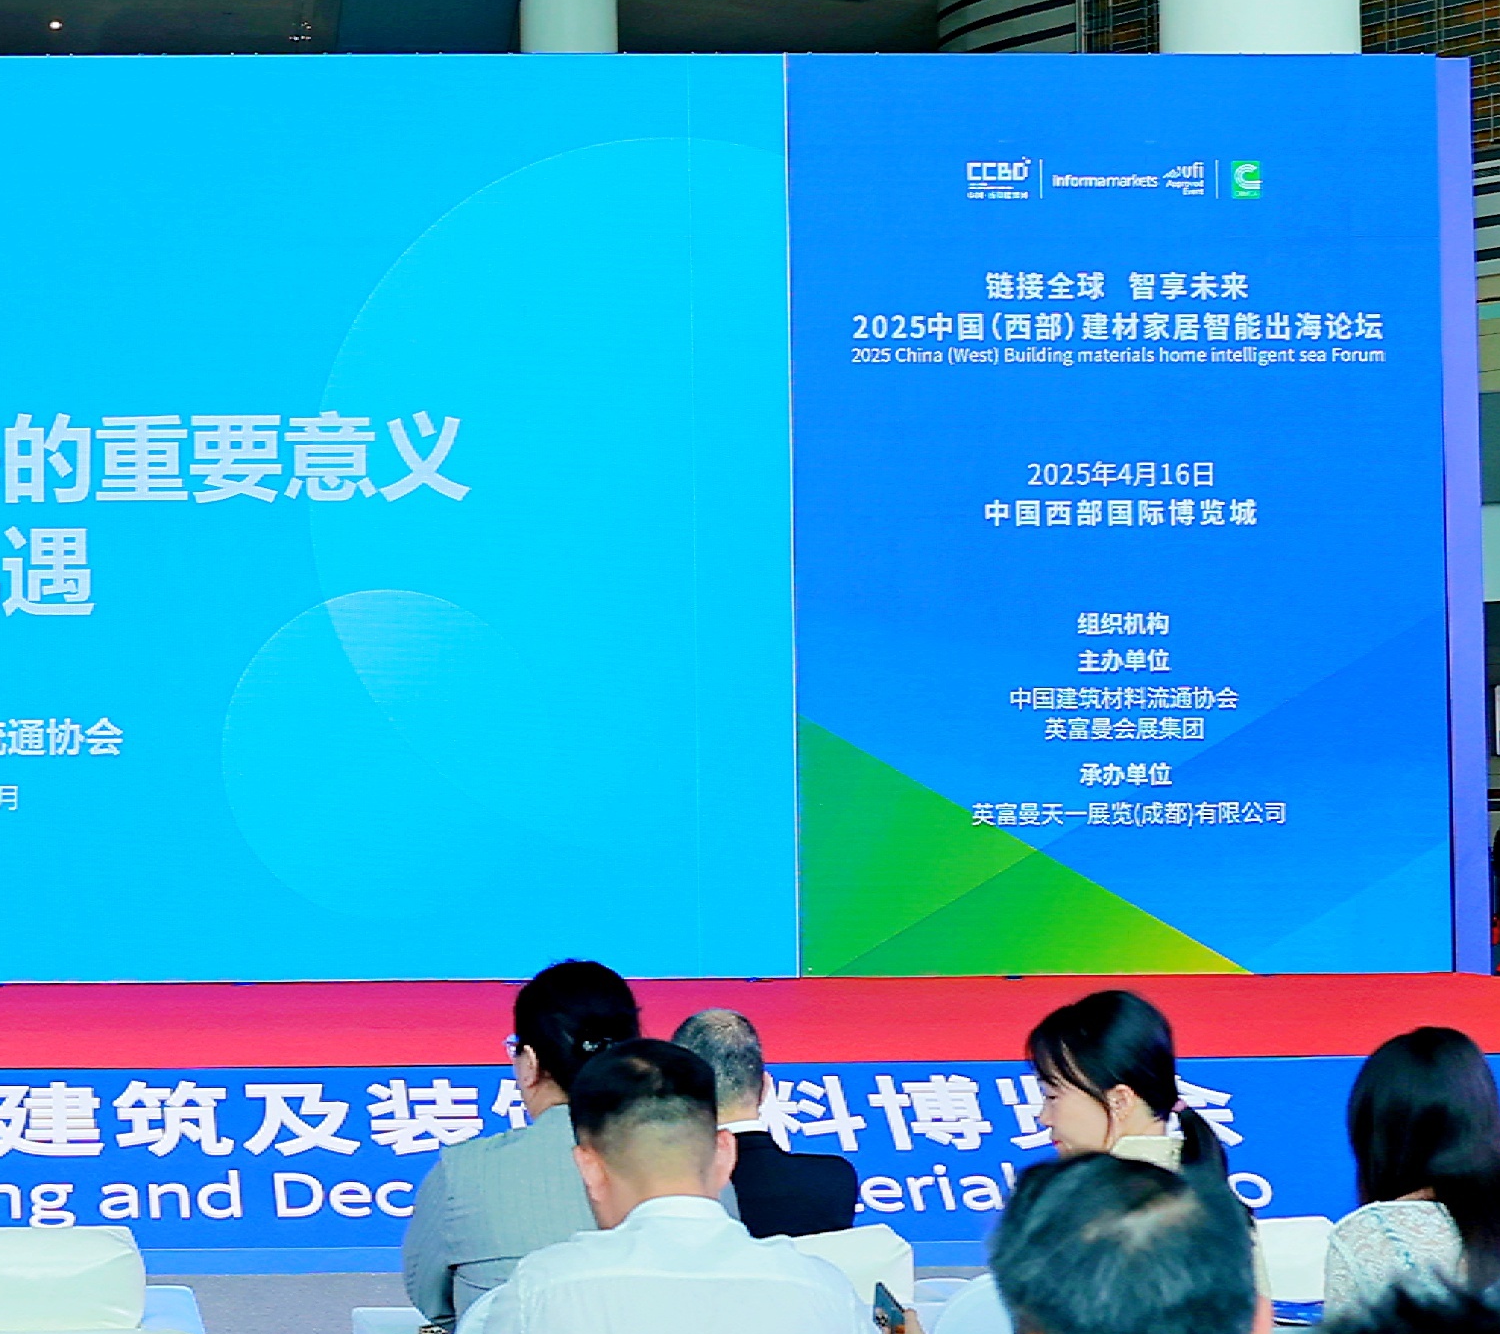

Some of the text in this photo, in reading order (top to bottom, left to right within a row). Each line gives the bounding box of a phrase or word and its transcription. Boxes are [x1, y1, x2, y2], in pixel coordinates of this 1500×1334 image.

[985, 271, 1249, 301] 链接全球 智享未来
[851, 346, 1386, 366] 2025 China (West) Building materials home intelligent sea Forum
[1027, 460, 1214, 488] 2025年4月16日
[984, 498, 1258, 527] 中国西部国际博览城
[1077, 611, 1170, 636] 组织机构
[1077, 648, 1171, 673] 主办单位
[1009, 685, 1240, 710] 中国建筑材料流通协会
[1044, 716, 1205, 741] 英富曼会展集团
[1079, 761, 1173, 787] 承办单位
[971, 801, 1287, 827] 英富曼天一展览(成都)有限公司
[96, 1170, 243, 1220] and
